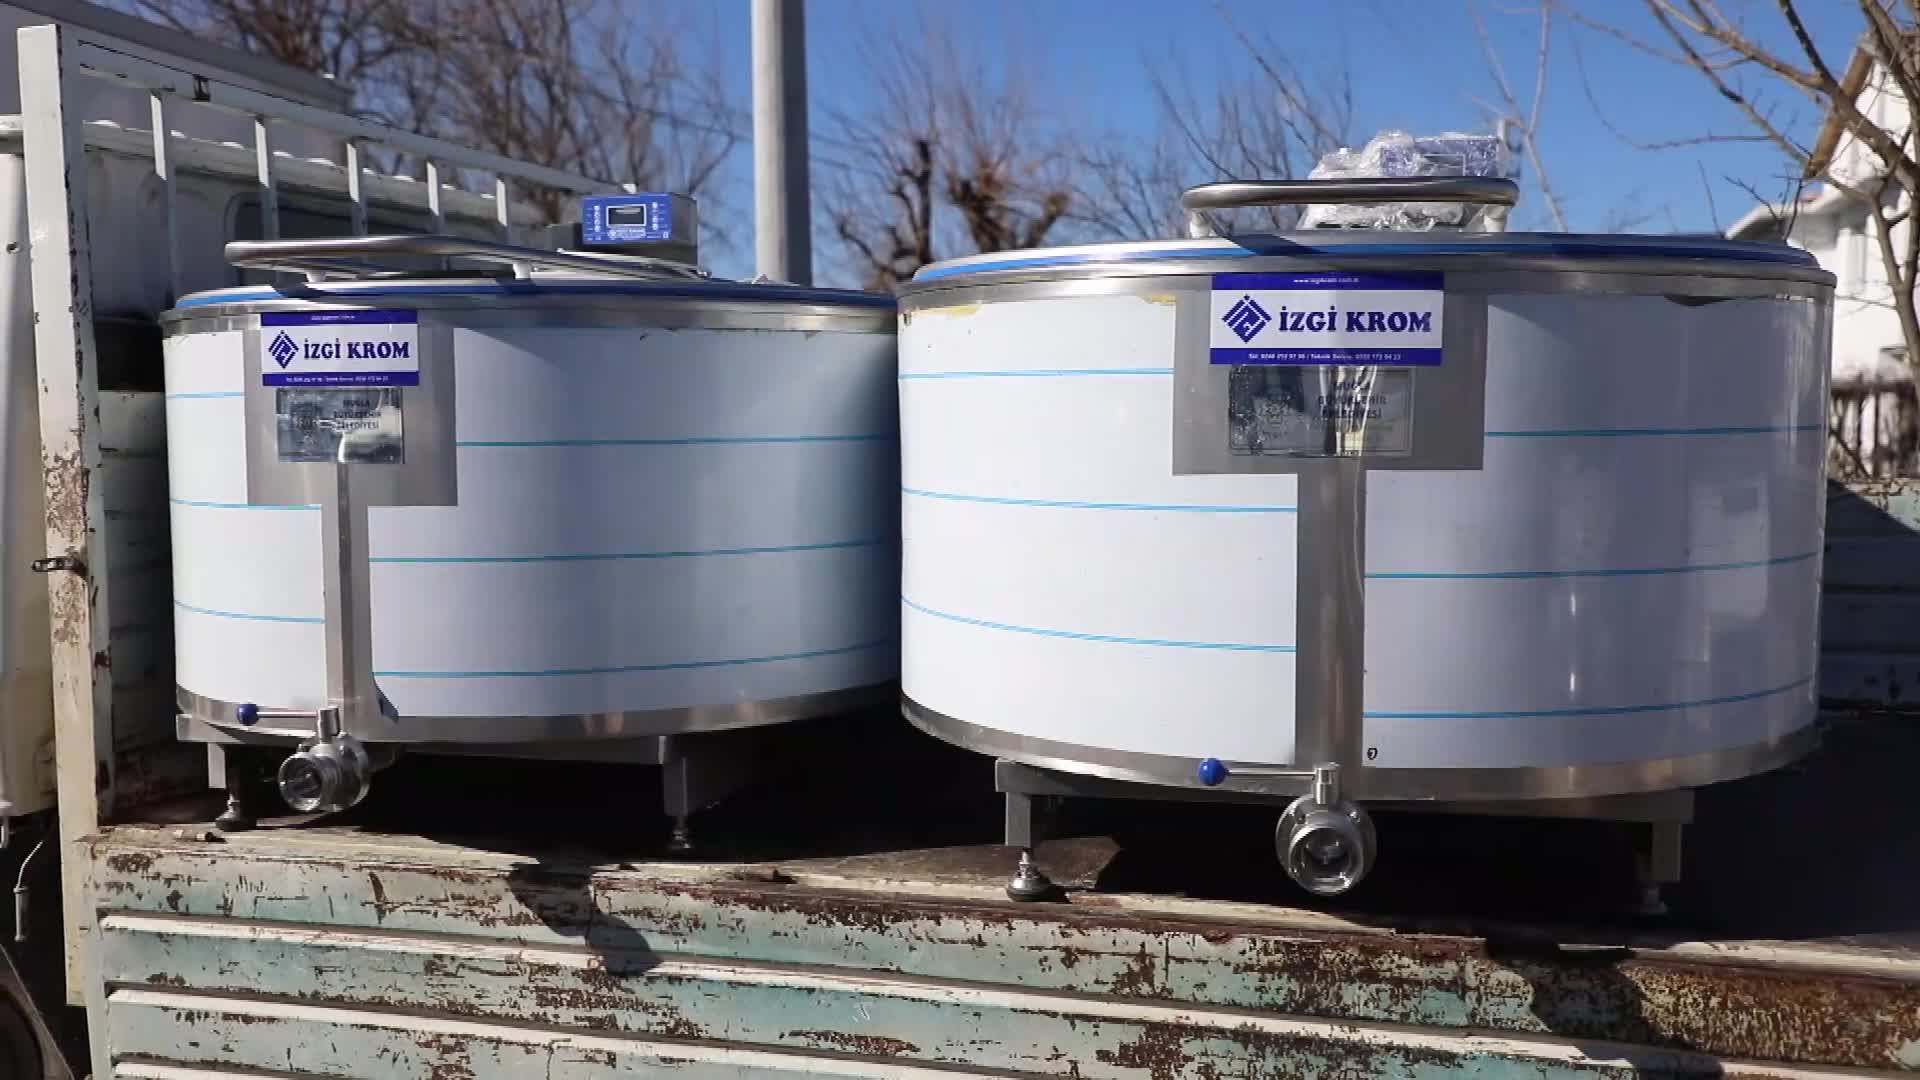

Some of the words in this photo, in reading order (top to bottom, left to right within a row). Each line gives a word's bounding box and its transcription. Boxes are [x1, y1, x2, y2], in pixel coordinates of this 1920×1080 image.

[1279, 306, 1338, 332] İZGİ
[1345, 311, 1432, 333] KROM
[304, 338, 342, 359] İZGİ
[347, 341, 410, 359] KROM
